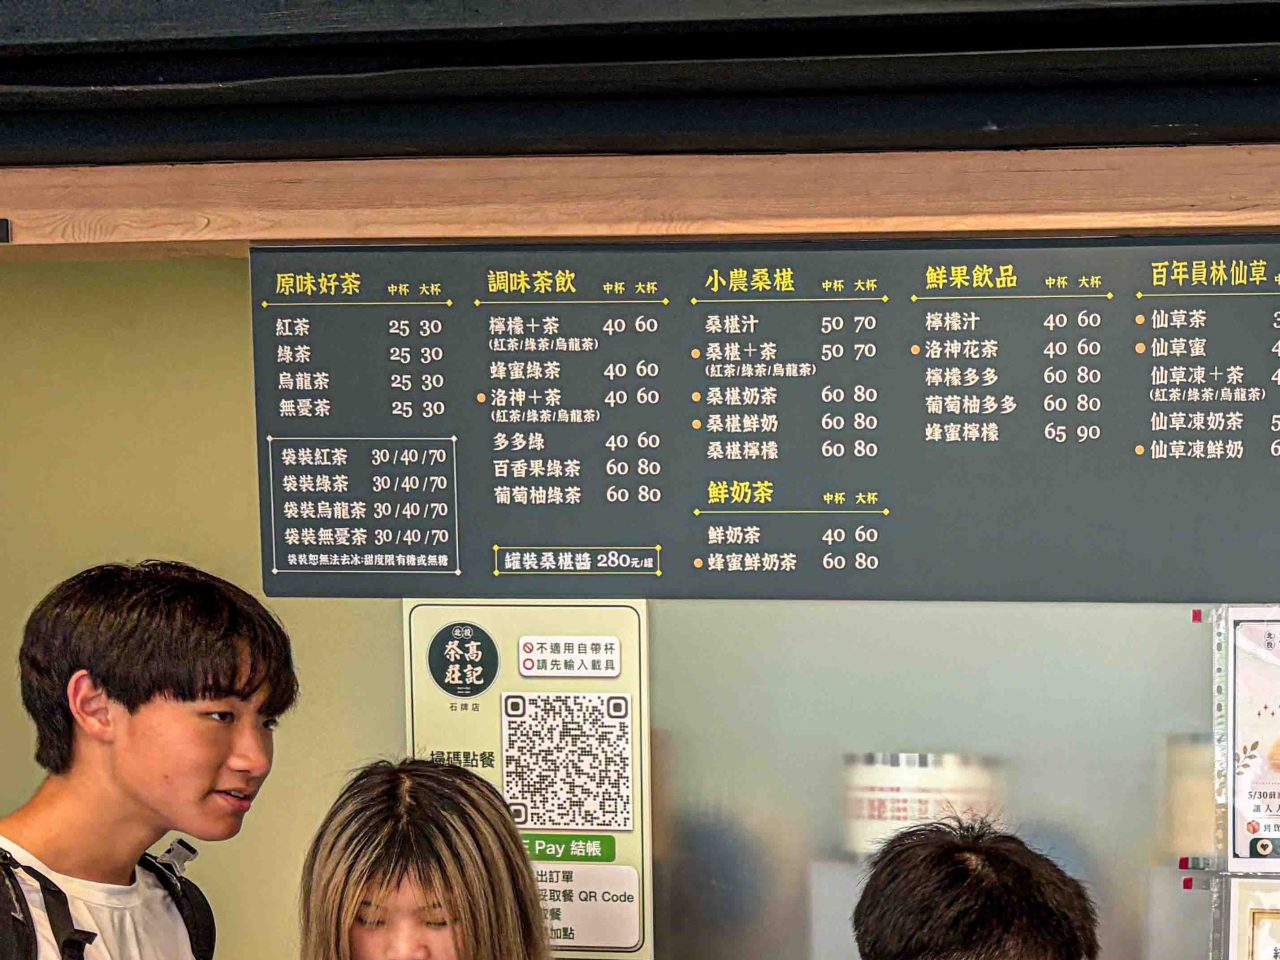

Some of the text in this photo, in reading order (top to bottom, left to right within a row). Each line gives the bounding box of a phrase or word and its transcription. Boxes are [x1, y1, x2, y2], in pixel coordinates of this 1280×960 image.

[488, 270, 576, 293] 調味茶飲
[705, 268, 795, 292] 小農桑椹
[926, 265, 1017, 289] 鮮果飲品
[1152, 260, 1267, 286] 百年員林仙草
[276, 272, 441, 295] 原味好茶 中杯 大杯
[276, 318, 442, 336] 紅茶 25 30
[603, 319, 625, 335] 40
[635, 316, 657, 332] 60
[705, 315, 876, 333] 桑椹汁 50 70
[926, 312, 980, 331] 檸檬汁
[1152, 309, 1206, 328] 仙草茶
[277, 345, 442, 363] 綠茶 25 30
[821, 344, 843, 361] 50
[854, 344, 876, 360] 70
[925, 340, 998, 358] 洛神花茶
[1151, 338, 1206, 357] 仙草蜜
[490, 360, 658, 380] 蜂蜜綠茶 40 60
[926, 368, 998, 386] 檸檬多多
[279, 372, 443, 391] 烏龍茶 25 30
[605, 391, 627, 407] 40
[637, 387, 659, 403] 60
[706, 385, 877, 405] 桑椹奶茶 60 80
[926, 395, 1016, 414] 葡萄柚多多
[280, 399, 444, 418] 無憂茶 25 30
[707, 413, 877, 432] 桑椹鮮奶 60 80
[1151, 411, 1243, 430] 仙草凍奶茶
[494, 432, 660, 451] 多多綠 40 60
[926, 423, 998, 441] 蜂蜜檸檬
[282, 448, 347, 465] 袋裝紅茶
[707, 440, 877, 459] 桑椹檸檬 60 80
[1151, 440, 1243, 459] 仙草凍鮮奶
[493, 459, 660, 477] 百香果綠茶 60 80
[283, 475, 348, 492] 袋裝綠茶
[708, 481, 773, 504] 鮮奶茶
[494, 485, 661, 504] 葡萄柚綠茶 60 80
[284, 501, 366, 519] 袋裝烏龍茶
[285, 528, 367, 545] 袋裝無憂茶
[708, 526, 877, 545] 鮮奶茶 40 60
[708, 553, 878, 571] 蜂蜜鮮奶茶 60 80
[450, 703, 480, 712] 石牌店
[536, 841, 565, 857] Pay
[571, 841, 601, 857] 結帳
[579, 890, 634, 902] QR Code
